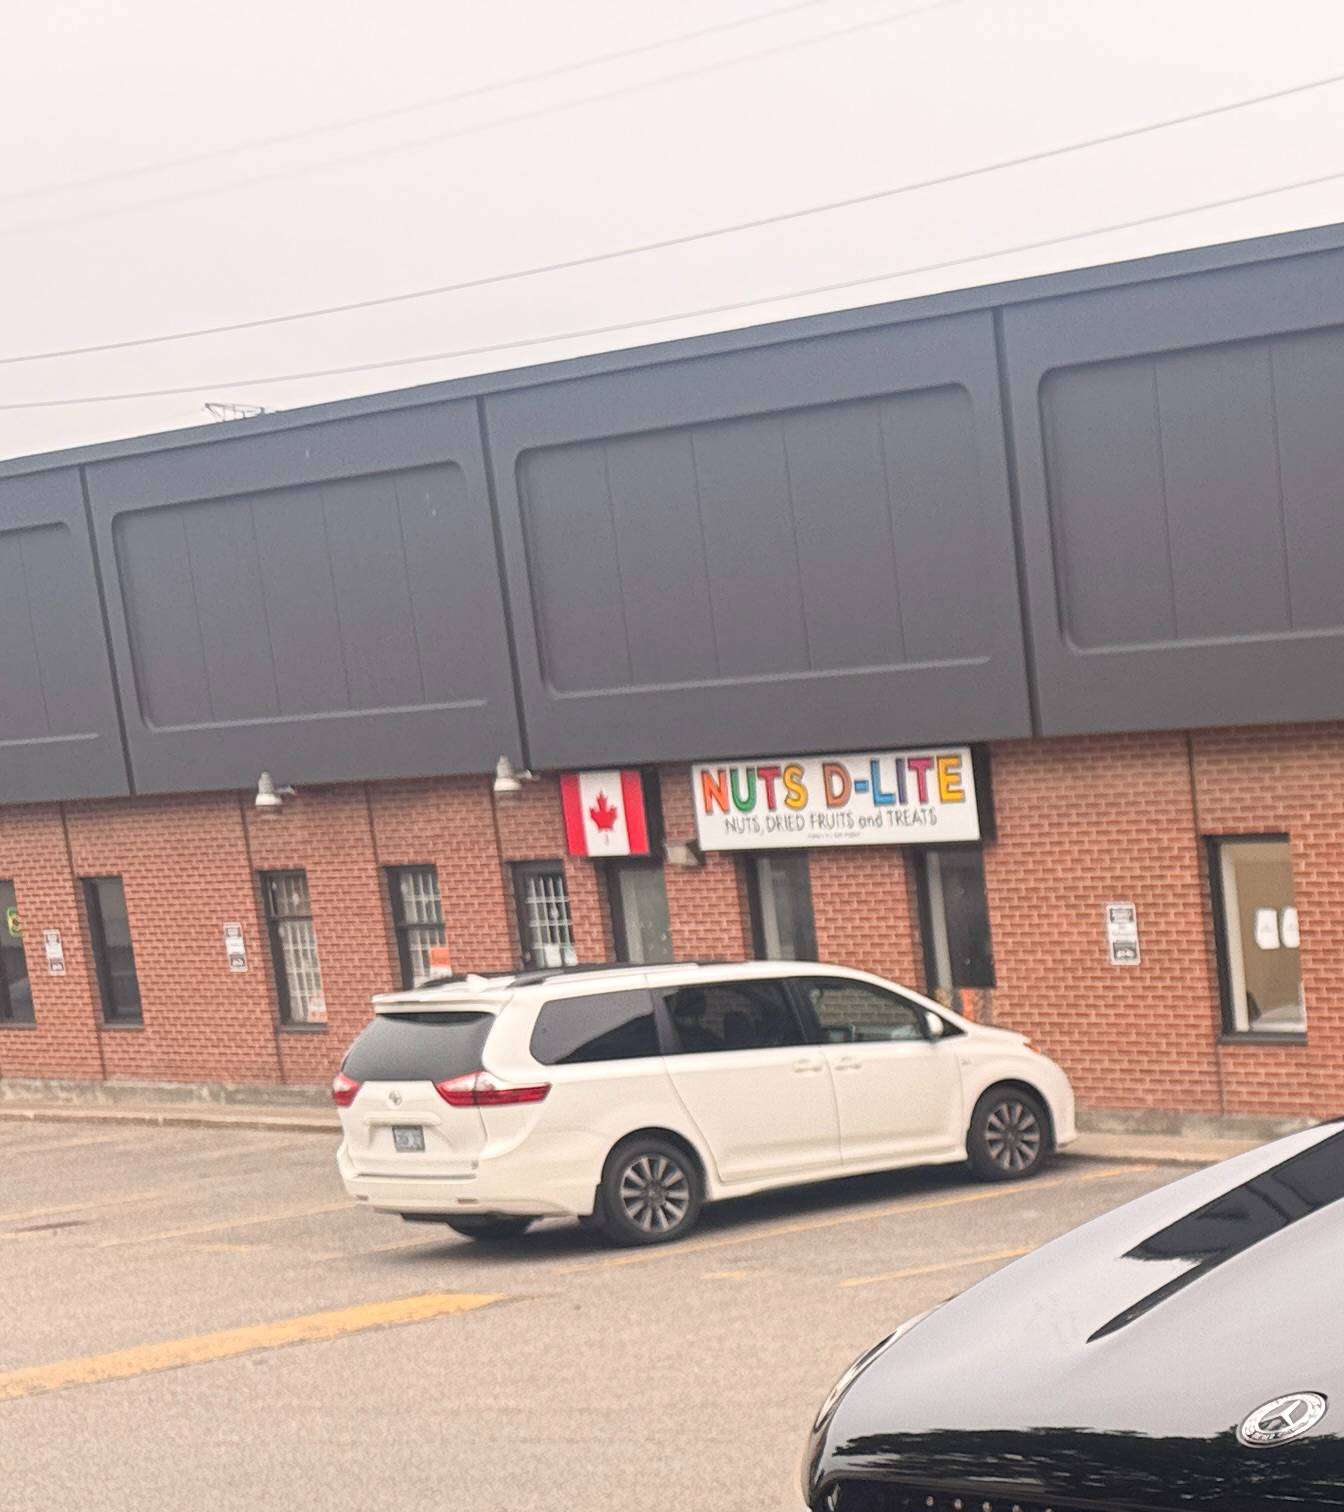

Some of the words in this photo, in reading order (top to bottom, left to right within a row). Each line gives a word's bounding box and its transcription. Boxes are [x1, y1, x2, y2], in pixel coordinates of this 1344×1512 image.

[700, 762, 809, 815] NUTS
[822, 753, 966, 809] D-LITE
[725, 815, 765, 836] NUTS,
[765, 813, 805, 833] DRIED
[809, 811, 855, 831] FRUITS
[858, 812, 883, 829] and
[888, 807, 938, 827] TREATS
